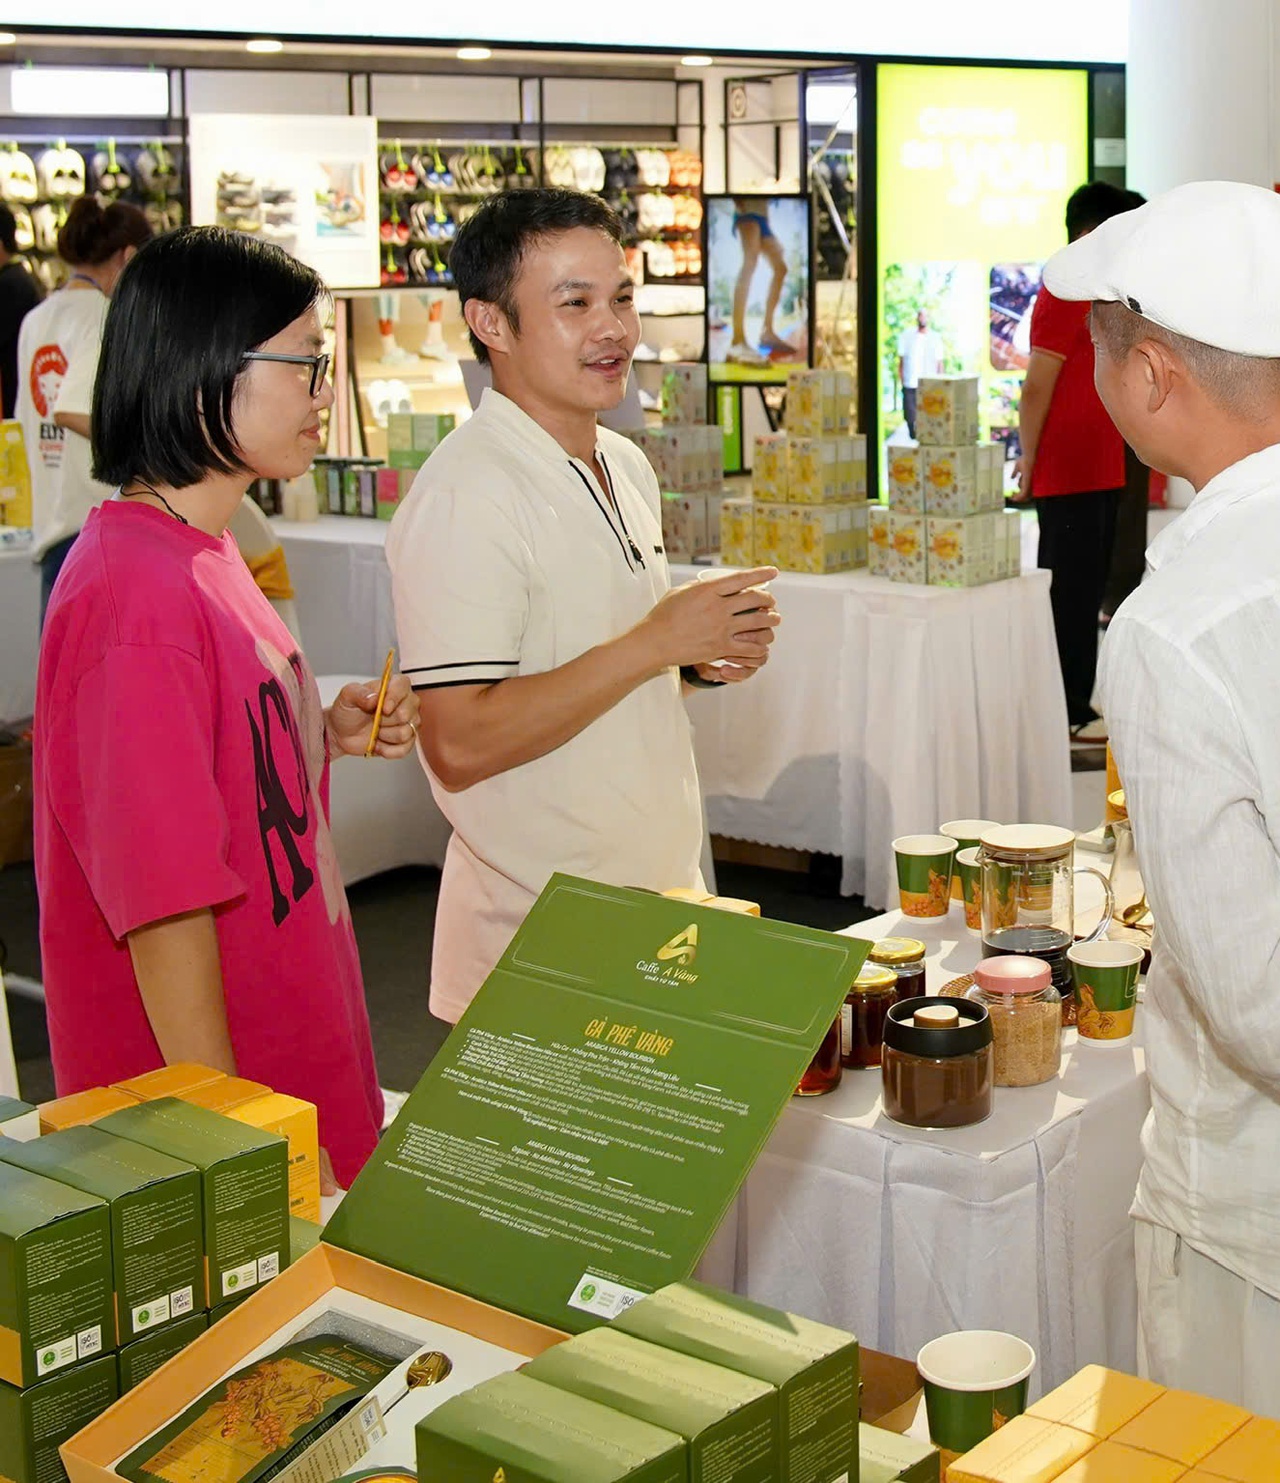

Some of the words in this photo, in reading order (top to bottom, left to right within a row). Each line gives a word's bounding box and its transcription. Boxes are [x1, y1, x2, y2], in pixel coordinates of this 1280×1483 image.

[636, 960, 659, 973] Caffe
[584, 1016, 606, 1038] CÀ
[604, 1023, 638, 1047] PHÊ
[634, 1029, 675, 1057] VÀNG
[621, 1295, 635, 1306] ISO
